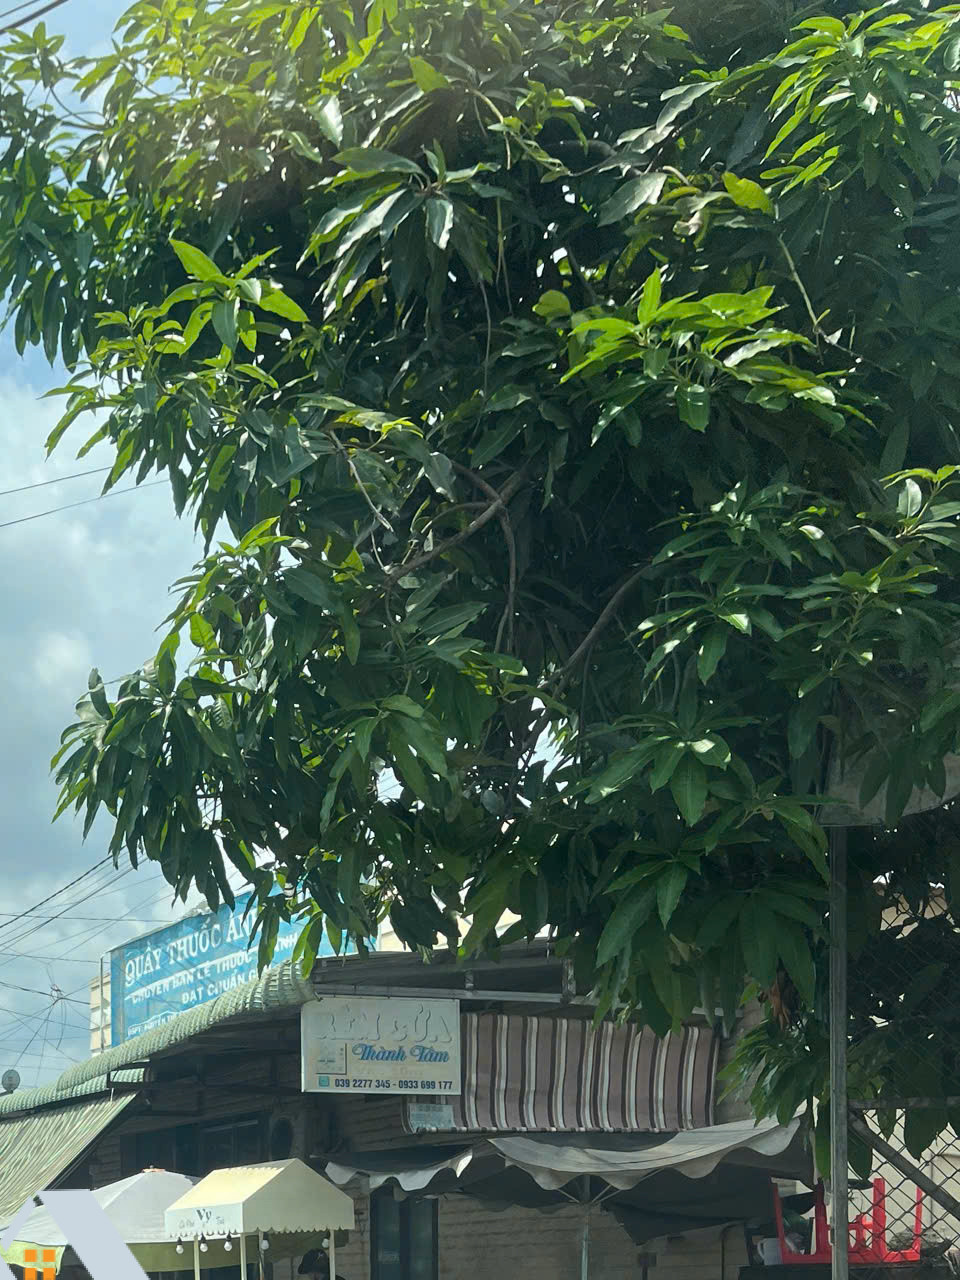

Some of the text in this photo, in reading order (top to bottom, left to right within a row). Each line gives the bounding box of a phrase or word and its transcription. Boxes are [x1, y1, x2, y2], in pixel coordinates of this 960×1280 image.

[124, 941, 162, 987] QUẦY
[167, 917, 222, 964] THUỐC
[351, 1043, 450, 1063] Thành Tâm
[334, 1079, 350, 1088] 039
[352, 1080, 373, 1089] 2277
[375, 1080, 391, 1089] 345
[398, 1080, 419, 1090] 0933
[421, 1081, 436, 1090] 699
[439, 1081, 453, 1090] 177
[196, 1208, 212, 1223] Vy
